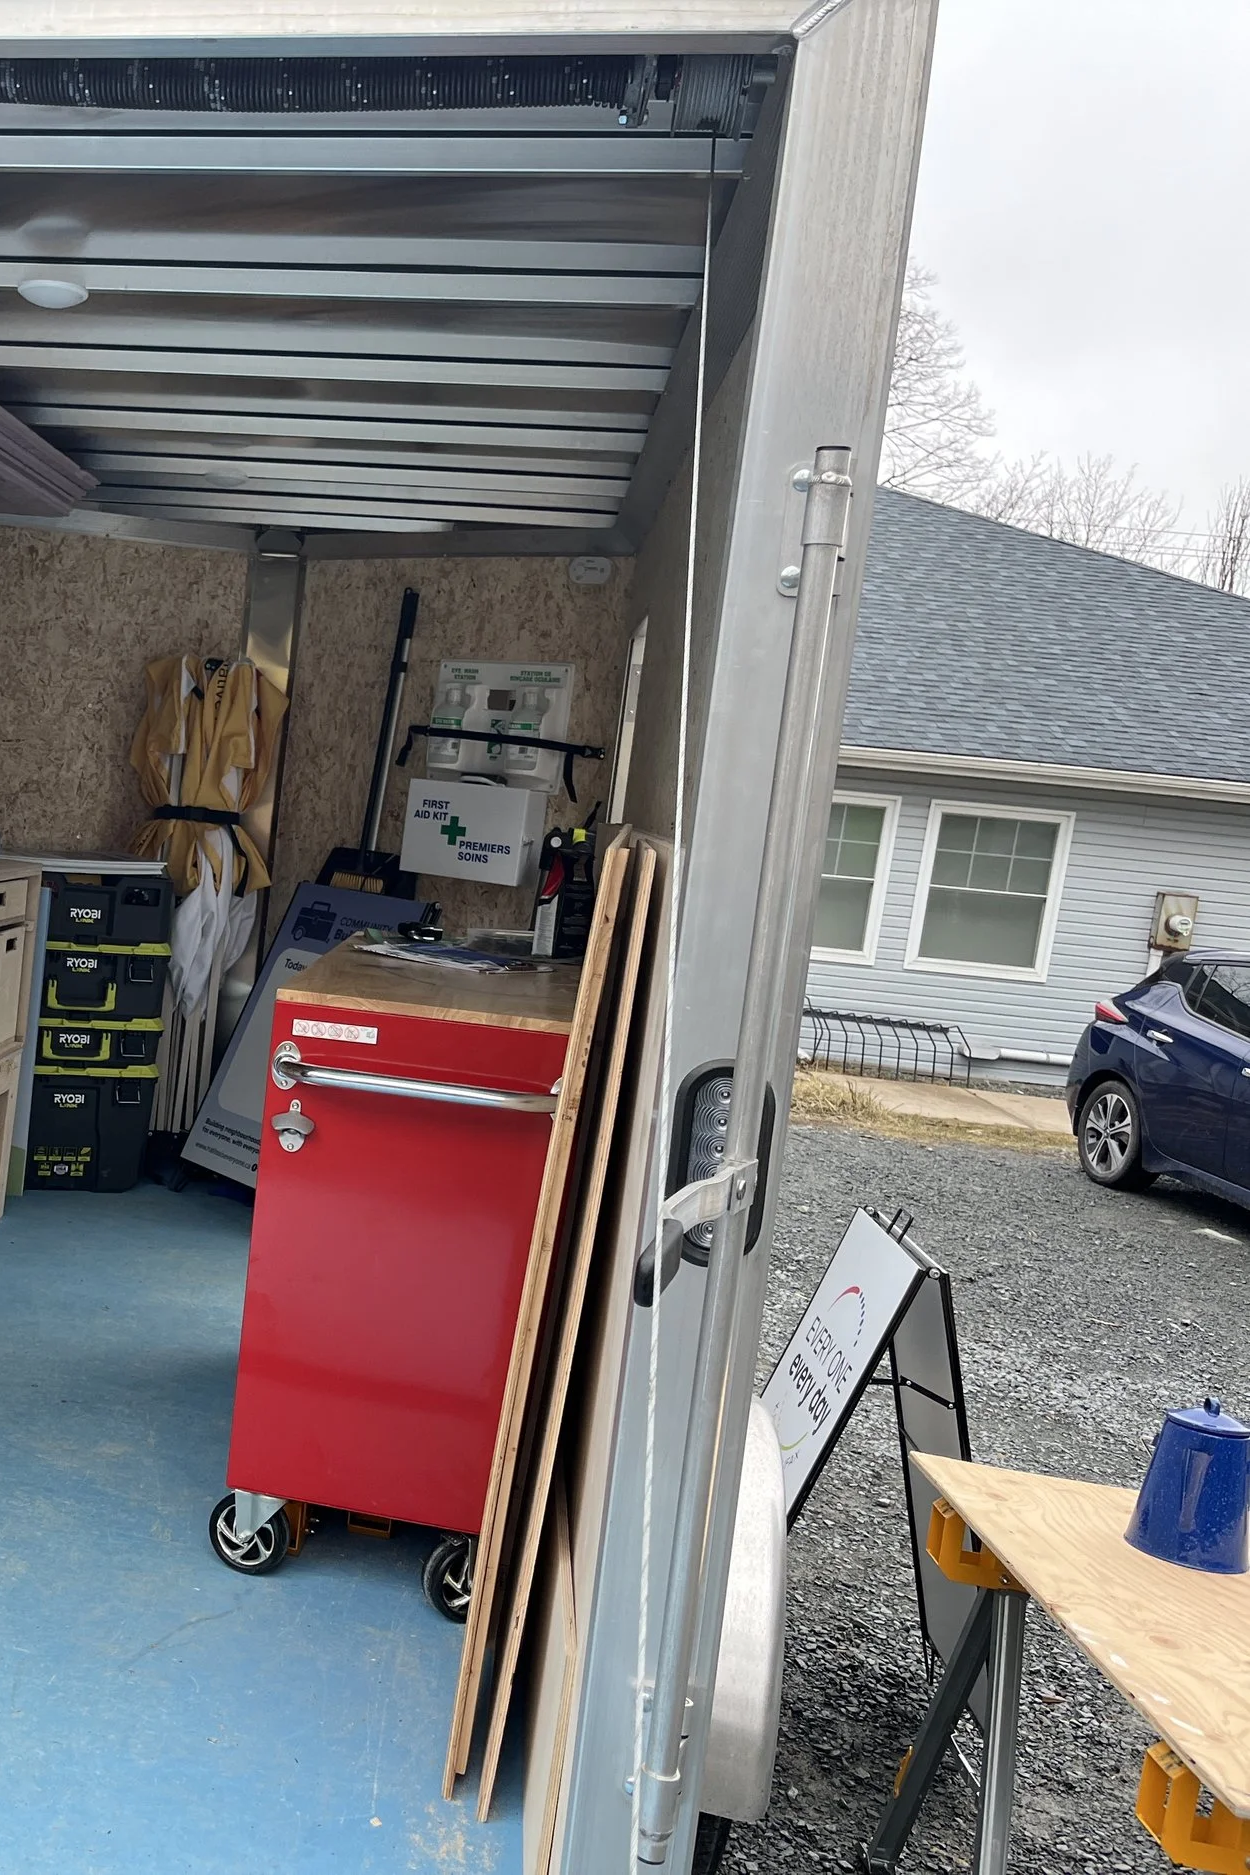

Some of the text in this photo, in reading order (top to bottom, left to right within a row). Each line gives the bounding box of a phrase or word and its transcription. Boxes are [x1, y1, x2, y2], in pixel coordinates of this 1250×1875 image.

[422, 799, 450, 810] FIRST
[414, 809, 449, 821] AID KIT
[459, 840, 511, 855] PREMIERS
[457, 852, 488, 863] SOINS
[70, 908, 101, 919] RYOBI
[66, 958, 98, 969] RYOBI
[59, 1034, 90, 1044] RYOBI
[54, 1094, 85, 1104] RYOBI
[806, 1316, 853, 1394] EVERY ONE
[789, 1353, 832, 1436] every day
